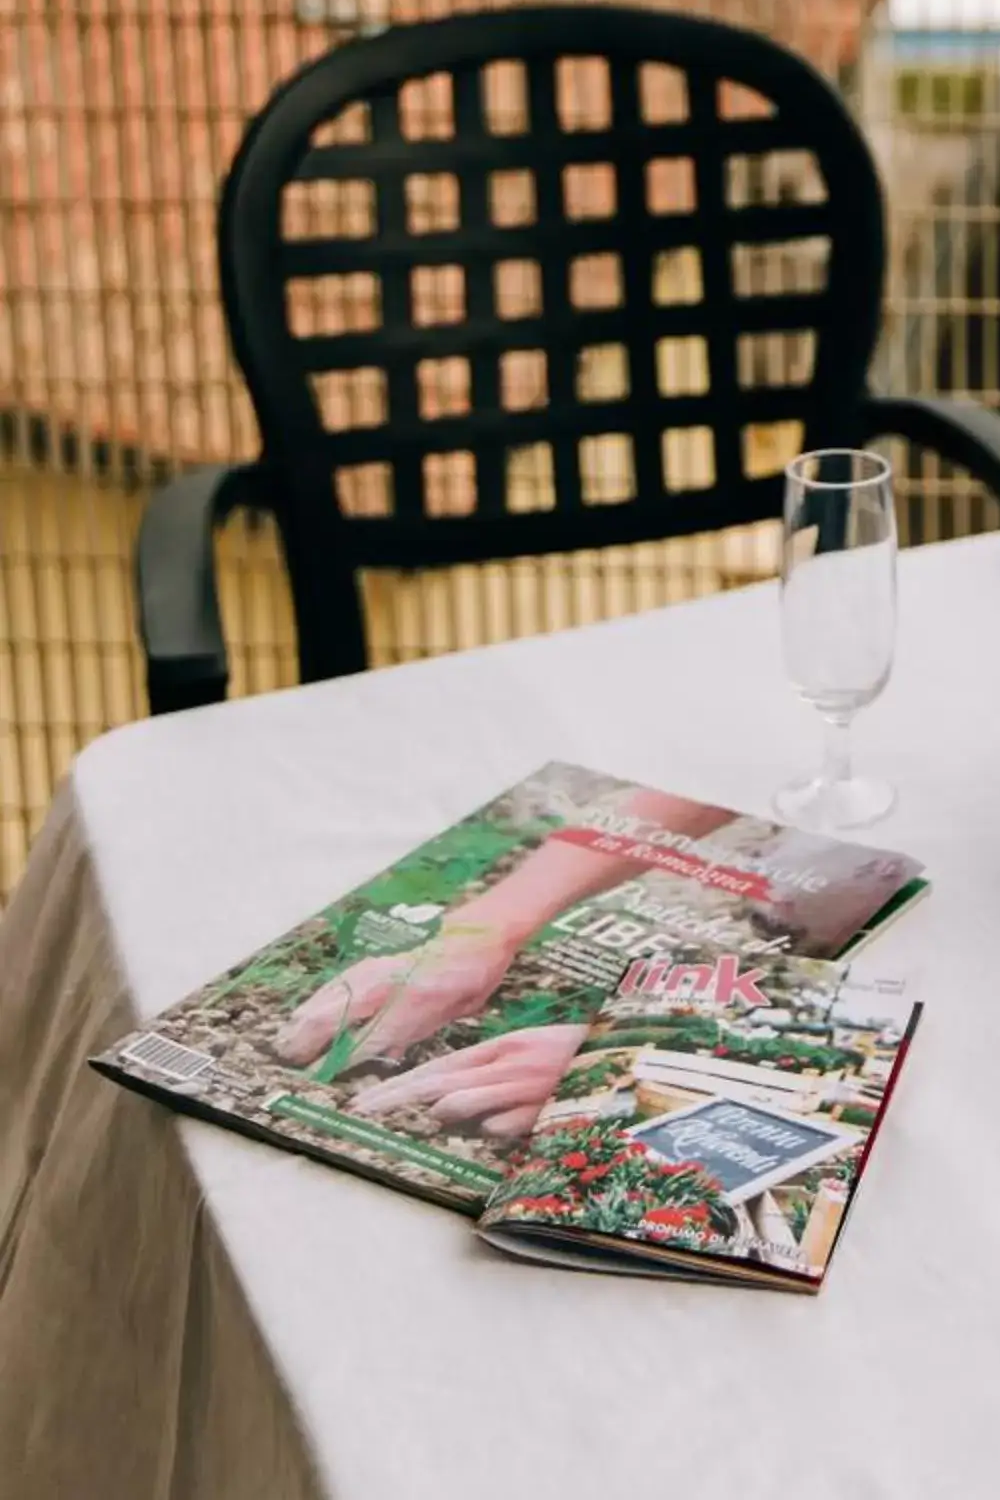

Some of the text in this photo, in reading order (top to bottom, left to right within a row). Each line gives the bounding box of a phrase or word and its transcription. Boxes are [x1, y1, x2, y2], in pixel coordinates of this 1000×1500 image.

[624, 844, 753, 893] Romagna
[551, 906, 703, 956] LIBE
[617, 953, 772, 1008] link
